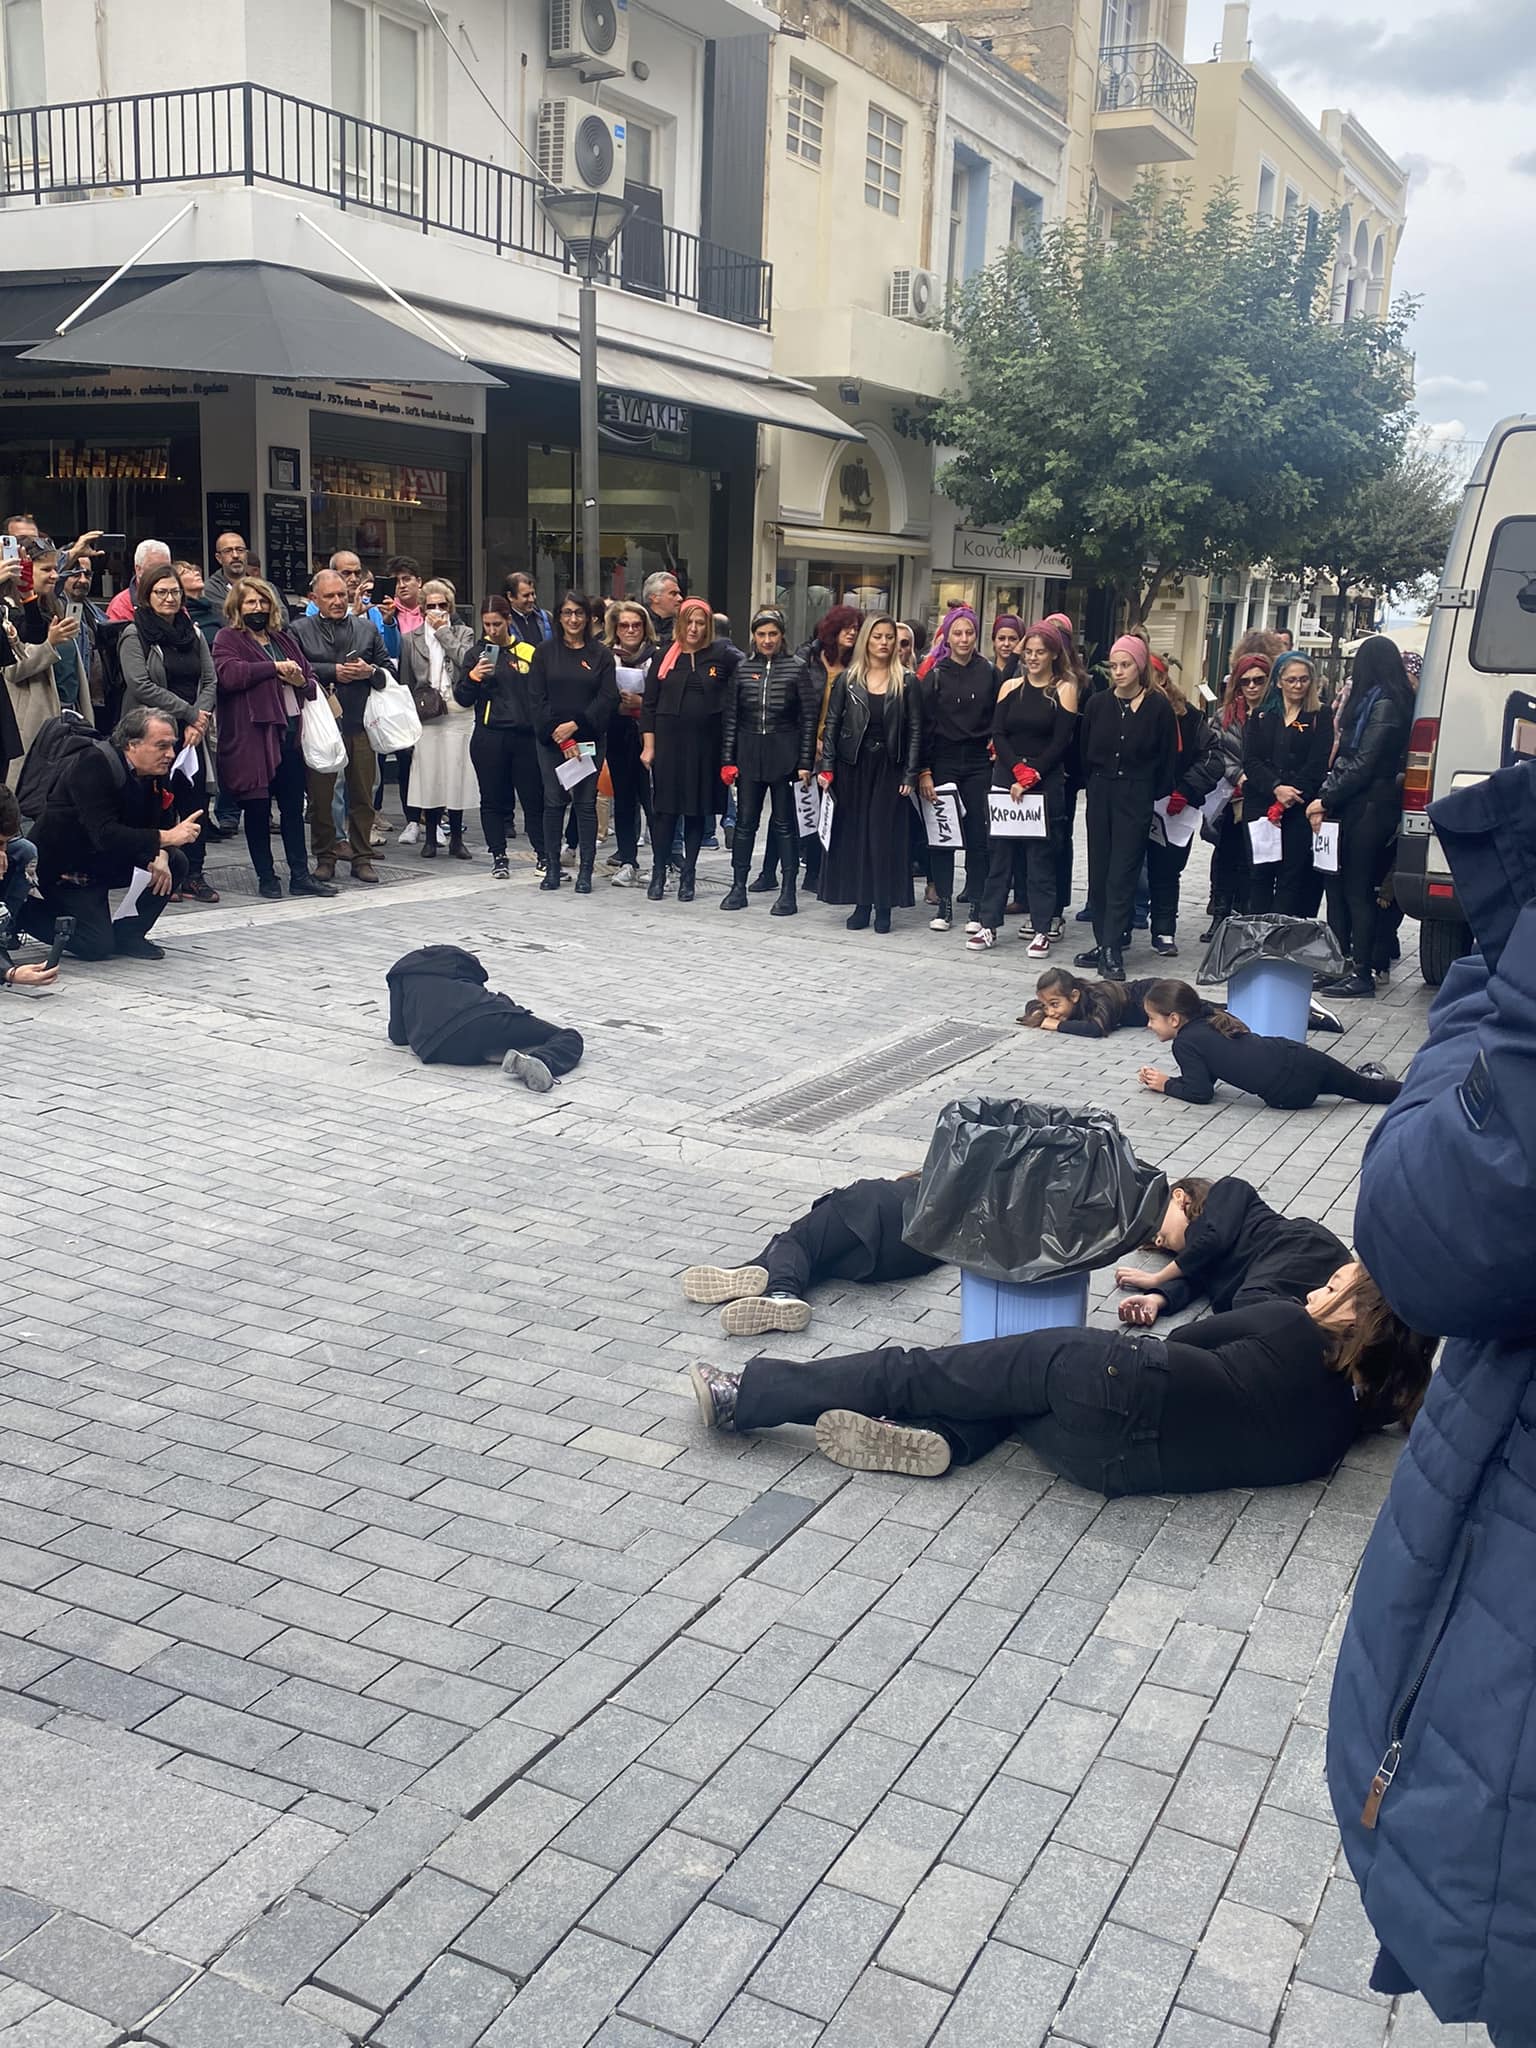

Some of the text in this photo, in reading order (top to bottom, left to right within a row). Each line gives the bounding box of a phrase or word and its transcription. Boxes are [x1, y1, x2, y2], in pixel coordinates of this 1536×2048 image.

[327, 393, 343, 404] 75%
[405, 406, 420, 416] 50%
[990, 805, 1041, 822] ΚΑΡΟΛΑΙΝ
